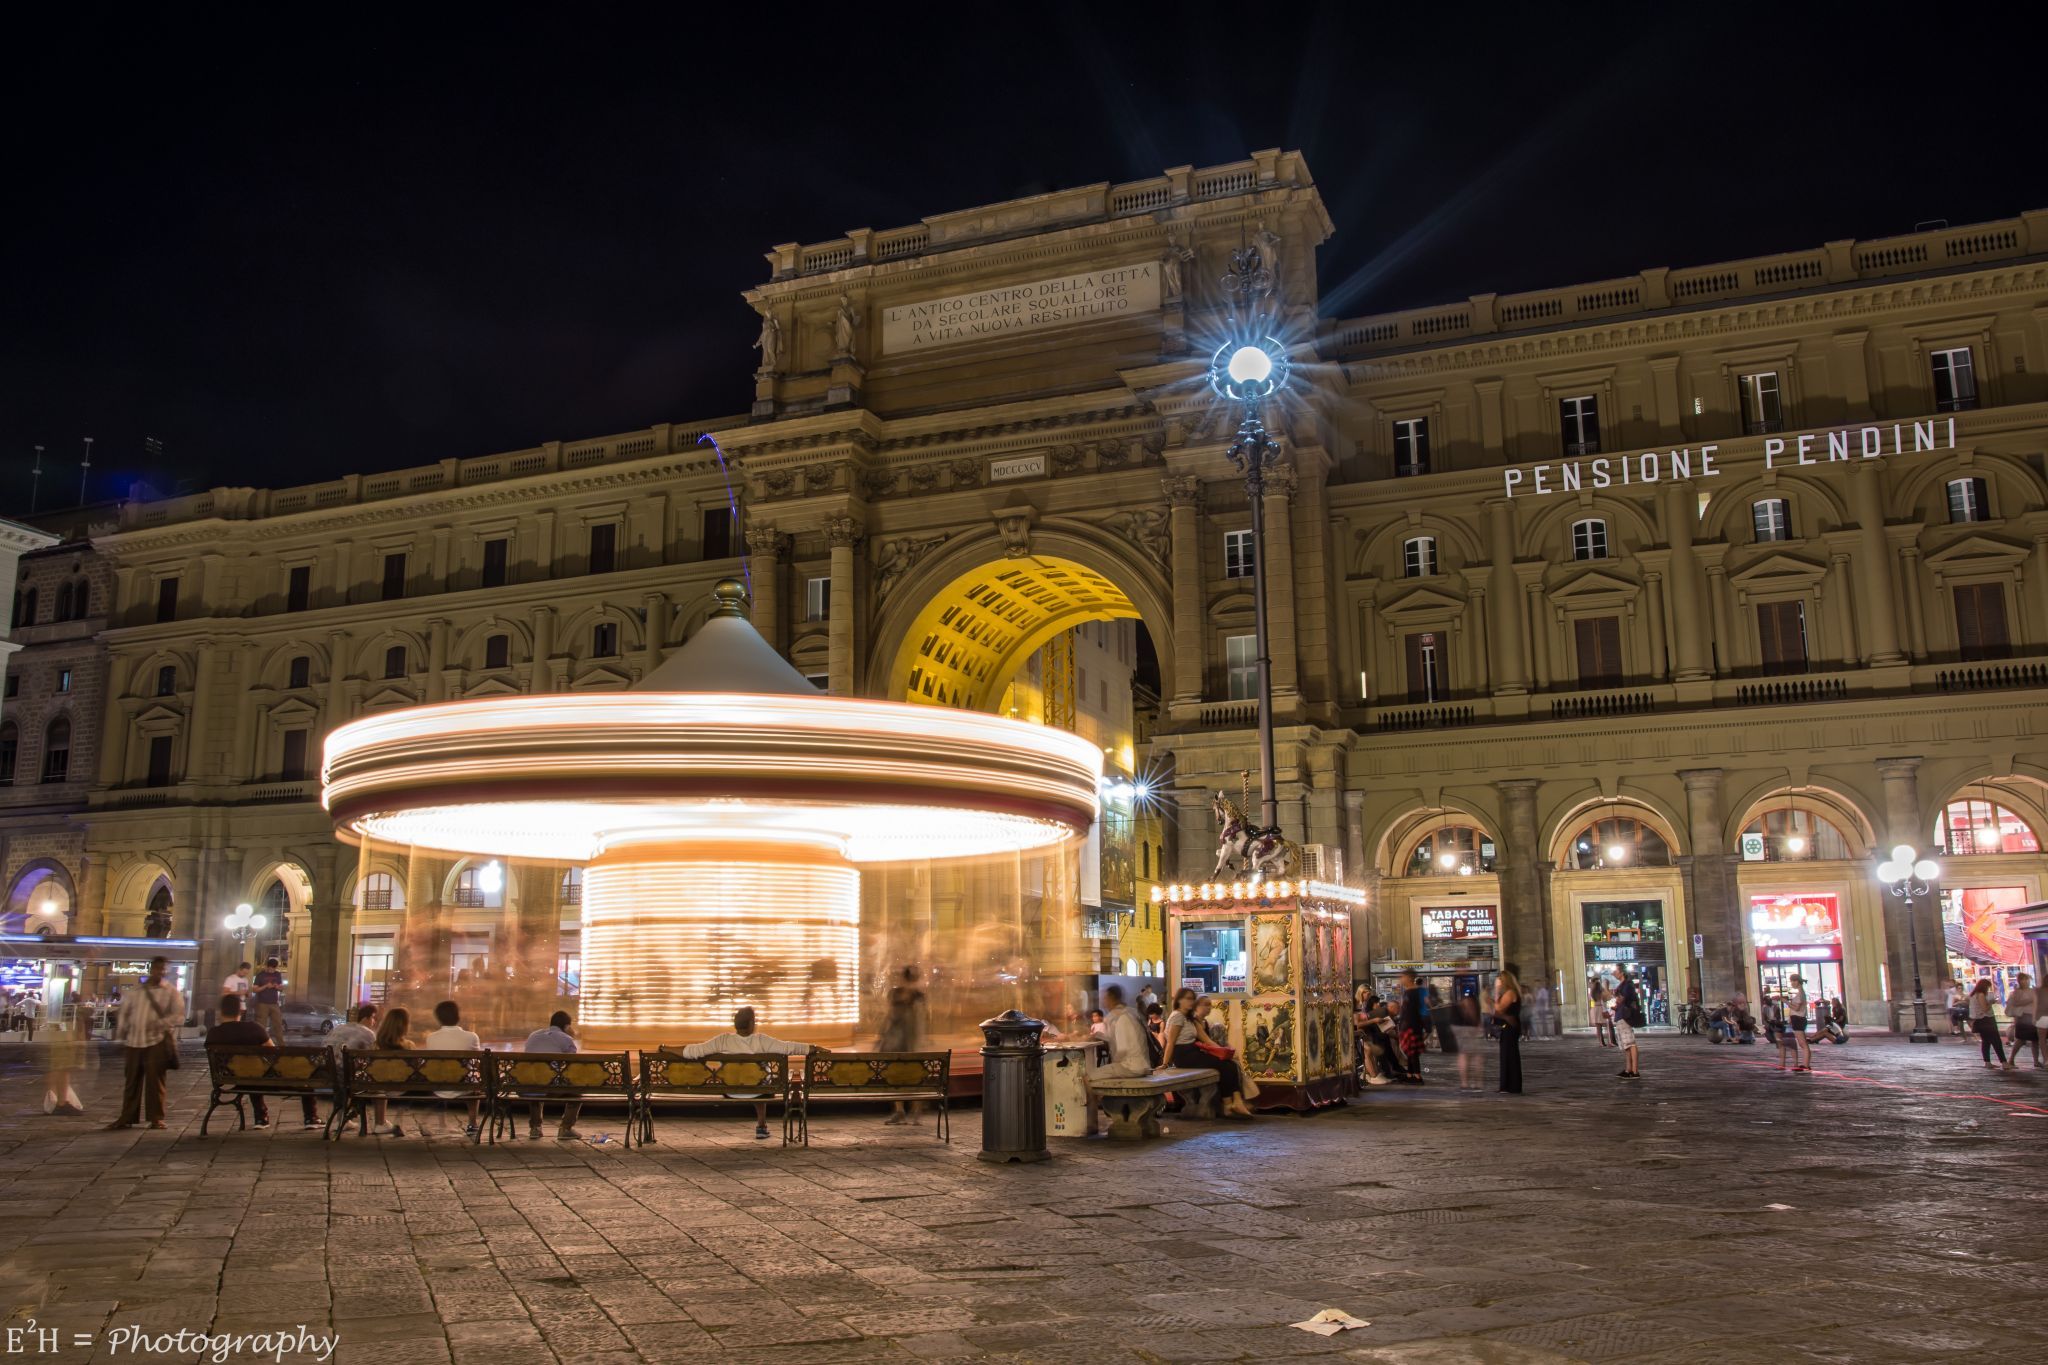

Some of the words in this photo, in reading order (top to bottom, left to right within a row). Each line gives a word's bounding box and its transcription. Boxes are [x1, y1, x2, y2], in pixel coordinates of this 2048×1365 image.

[908, 300, 963, 319] ANTICO
[969, 287, 1033, 308] CENTRO
[1039, 276, 1094, 296] DELLA
[913, 318, 932, 332] DA
[939, 302, 1022, 327] SECOLARE
[1028, 284, 1128, 311] SQUALLORE
[912, 334, 922, 344] A
[929, 327, 964, 342] VITA
[970, 316, 1024, 336] NUOVA
[1030, 298, 1129, 325] RESTITUITO
[993, 461, 1042, 478] MDCCCXCV
[1504, 445, 1720, 498] PENSIONE
[1765, 417, 1956, 469] PENDINI
[1429, 909, 1489, 920] TABACCHI
